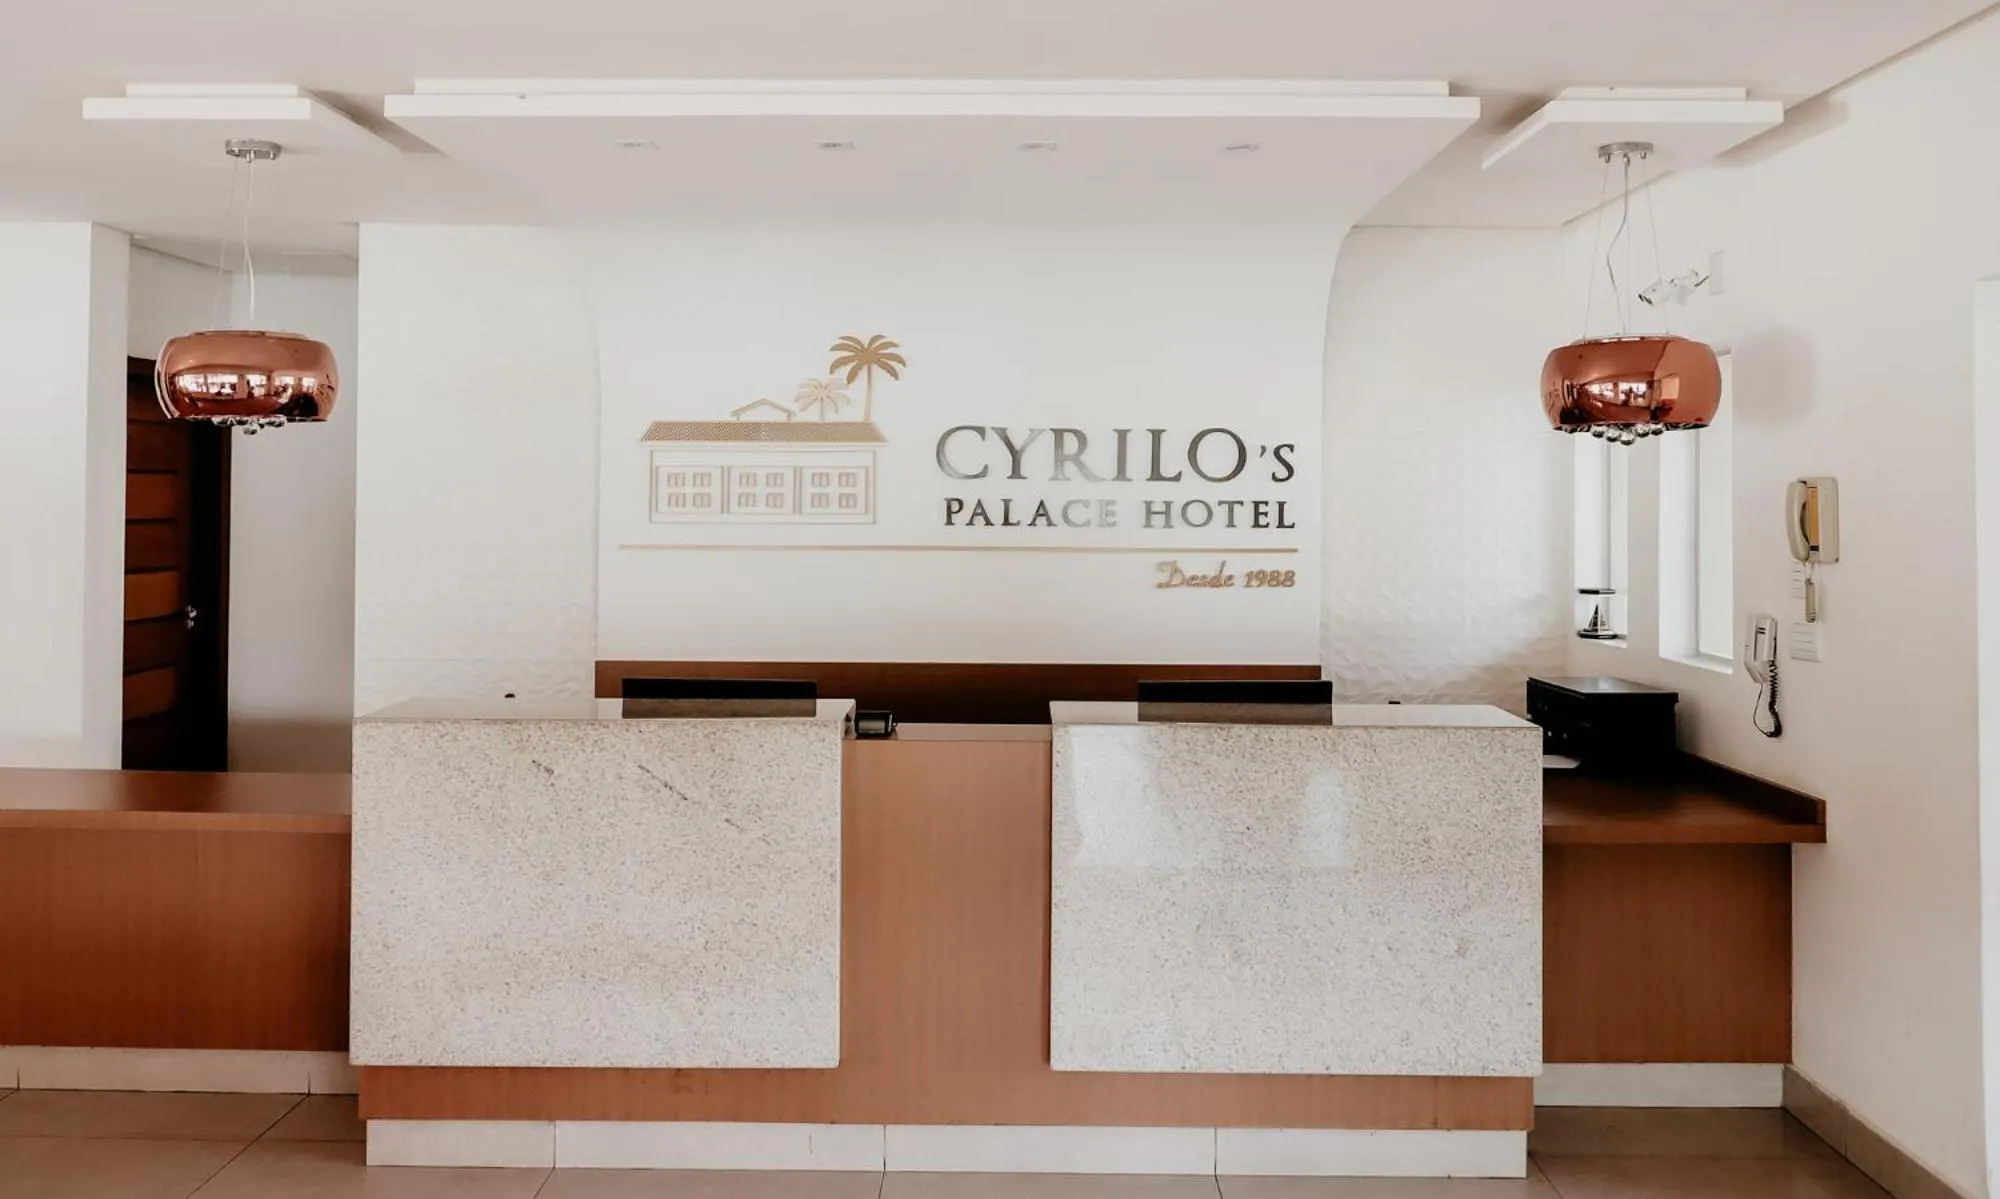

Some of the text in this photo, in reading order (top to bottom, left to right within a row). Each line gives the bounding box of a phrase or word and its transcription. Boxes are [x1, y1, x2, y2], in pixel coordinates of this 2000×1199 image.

[944, 498, 1295, 528] PALACE HOTEL
[1156, 560, 1295, 589] Desde 1988
